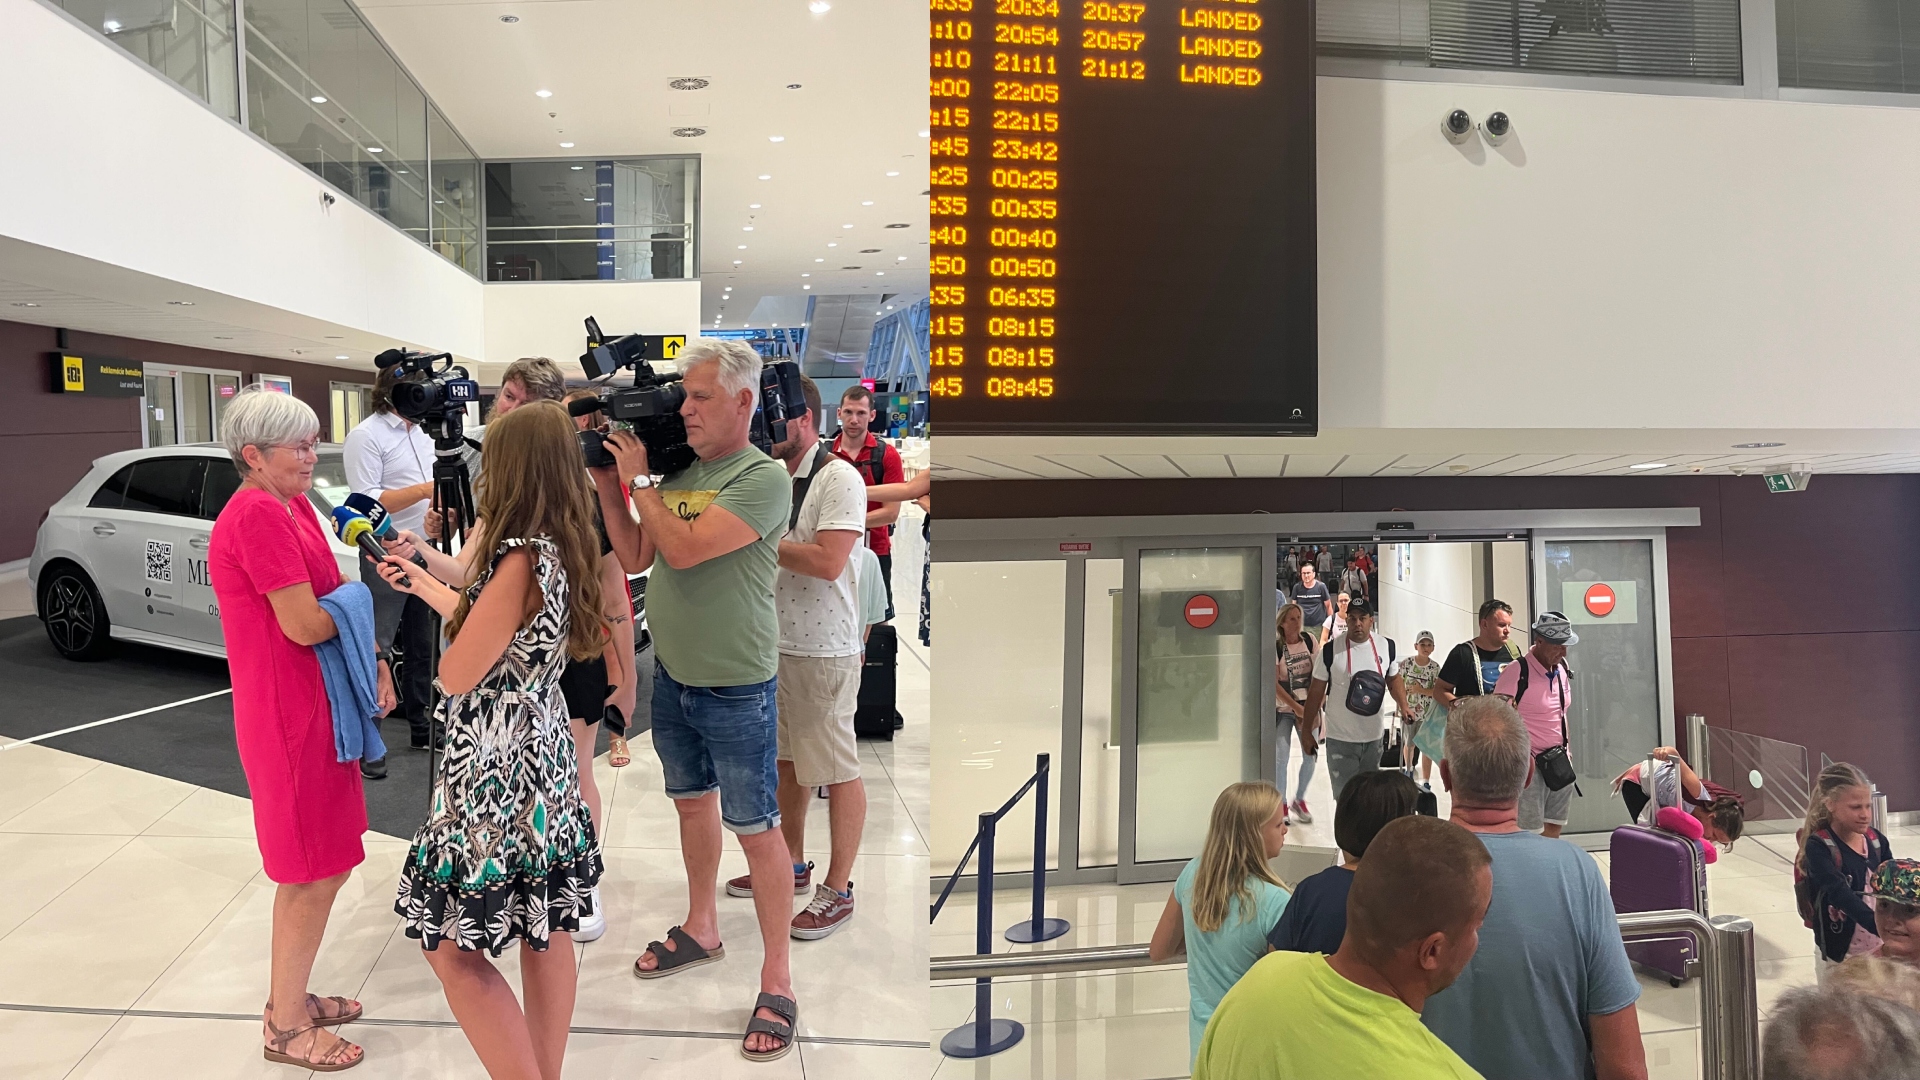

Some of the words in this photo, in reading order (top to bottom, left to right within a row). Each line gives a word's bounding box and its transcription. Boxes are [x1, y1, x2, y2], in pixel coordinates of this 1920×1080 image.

[930, 0, 973, 11] :35
[996, 0, 1060, 18] 20:34
[1083, 1, 1146, 23] 20:37
[1181, 8, 1262, 31] LANDED
[930, 20, 972, 41] :10
[995, 23, 1060, 46] 20:54
[1083, 29, 1145, 51] 20:57
[1181, 36, 1262, 59] LANDED
[930, 49, 971, 69] :10
[994, 52, 1057, 75] 21:11
[1082, 58, 1145, 80] 21:12
[1181, 64, 1262, 86] LANDED
[930, 78, 970, 98] :00
[994, 81, 1059, 104] 22:05
[930, 107, 970, 128] :15
[993, 110, 1059, 132] 22:15
[930, 136, 969, 157] :45
[992, 139, 1058, 161] 23:42
[991, 168, 1058, 190] 00:25
[991, 198, 1057, 219] 00:35
[990, 227, 1057, 248] 00:40
[990, 257, 1056, 278] 00:50
[989, 287, 1055, 307] 06:35
[988, 317, 1055, 337] 08:15
[988, 347, 1054, 367] 08:15
[452, 385, 469, 397] HN
[987, 377, 1053, 397] 08:45
[208, 604, 222, 619] Ob
